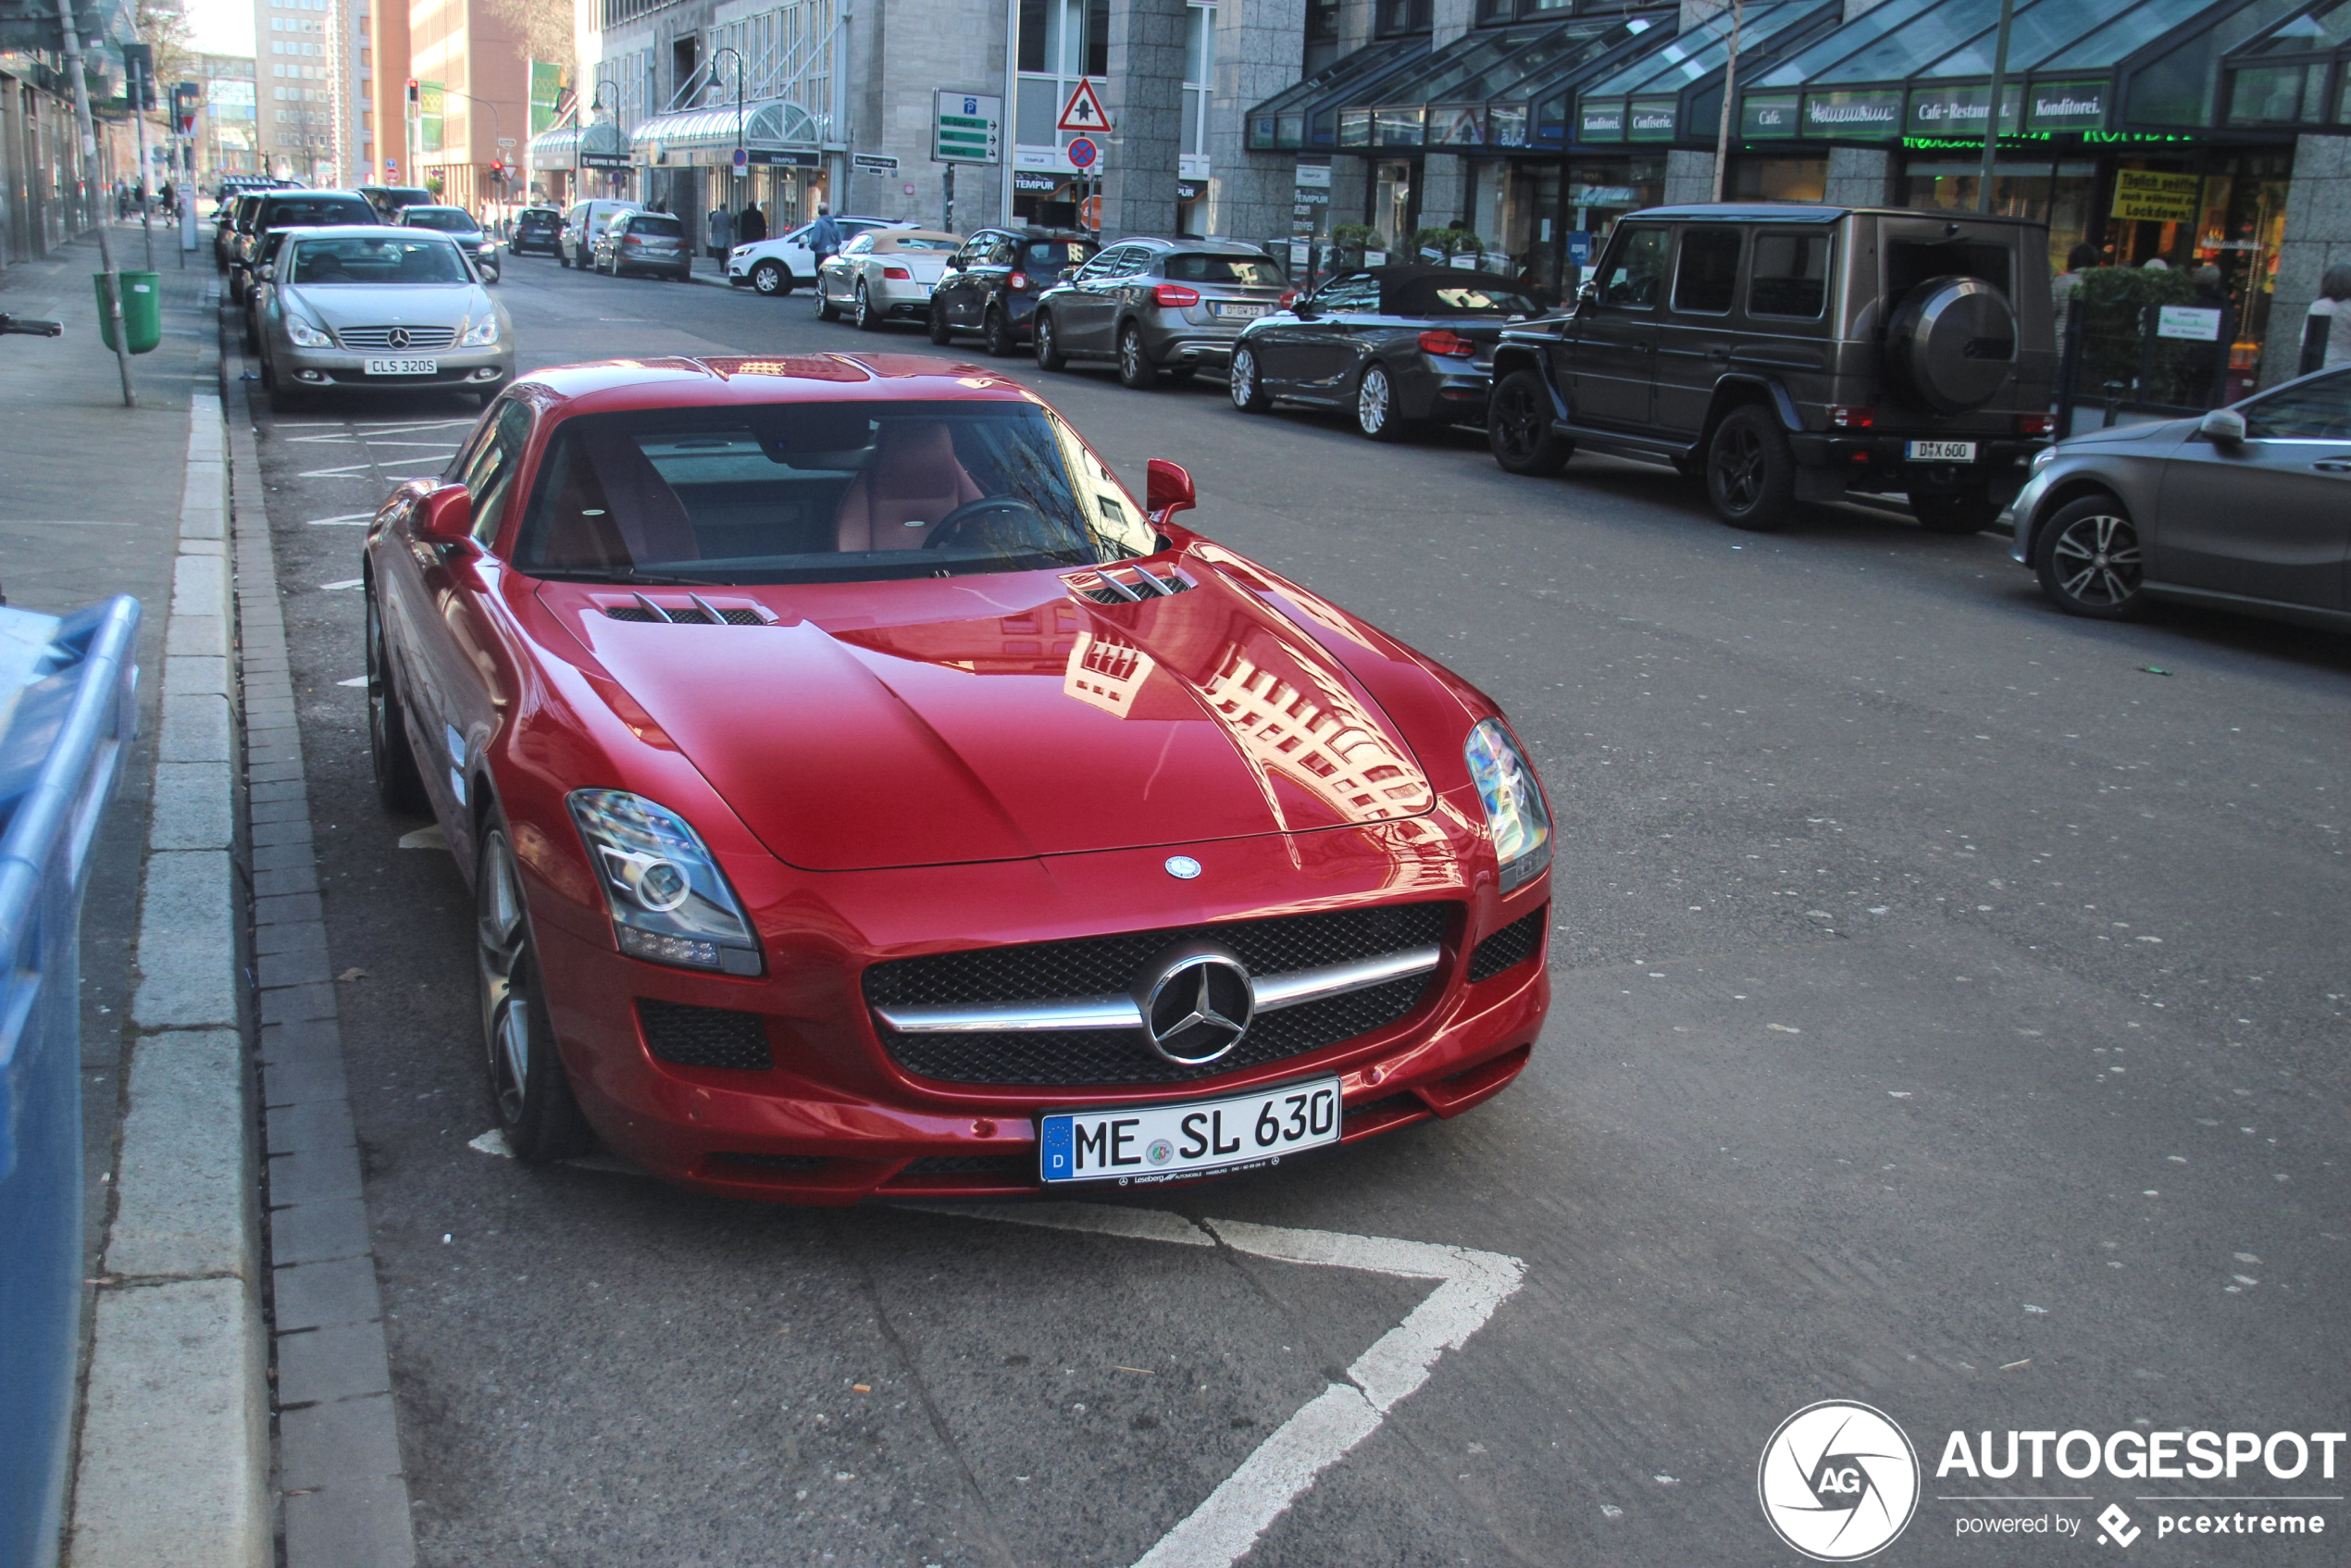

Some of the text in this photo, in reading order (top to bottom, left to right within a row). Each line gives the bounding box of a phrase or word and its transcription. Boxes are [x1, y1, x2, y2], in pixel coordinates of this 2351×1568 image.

[2035, 95, 2101, 117] Konditorei.
[770, 156, 798, 165] TEMPUR
[1015, 180, 1054, 191] TEMPUR
[2125, 204, 2194, 222] Lockdown!
[1237, 306, 1249, 316] GW
[1250, 306, 1260, 316] 12
[372, 360, 398, 372] CLS
[1919, 442, 1967, 458] D X 600
[1075, 1118, 1142, 1170] ME
[1179, 1110, 1240, 1159] SL
[1254, 1089, 1333, 1148] 630
[1052, 1153, 1064, 1168] D
[1134, 1175, 1164, 1184] Leseberg
[1175, 1171, 1202, 1179] AUTOMOBILE
